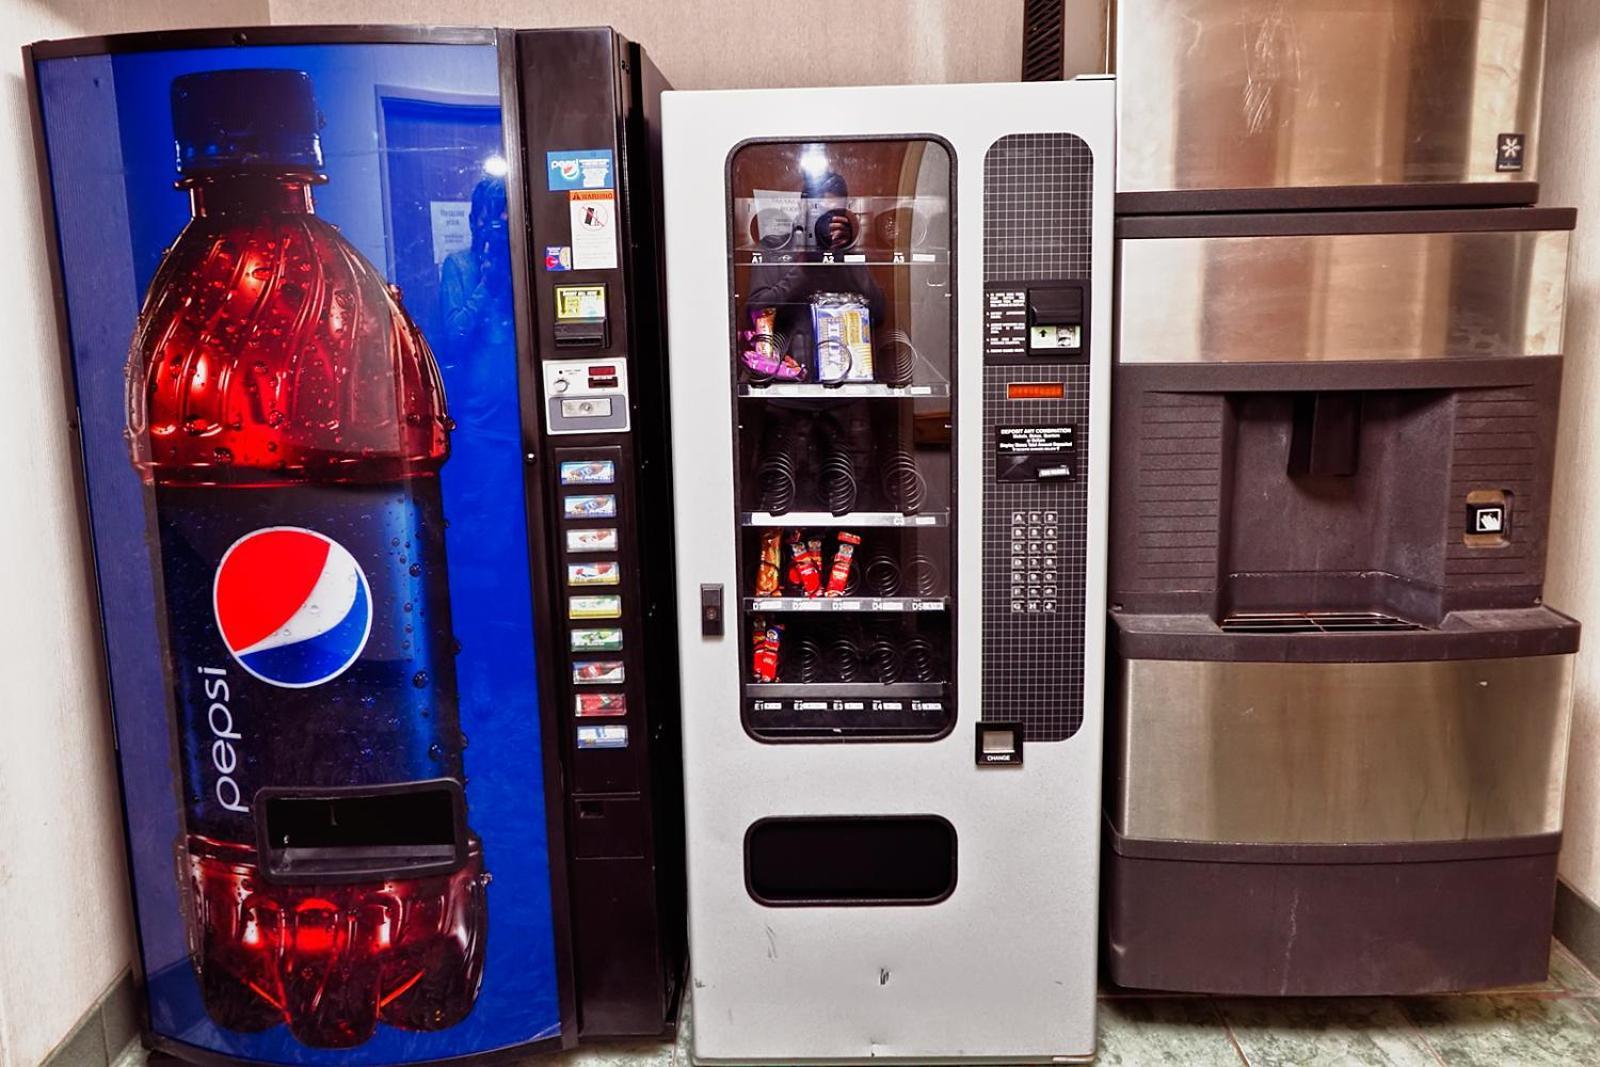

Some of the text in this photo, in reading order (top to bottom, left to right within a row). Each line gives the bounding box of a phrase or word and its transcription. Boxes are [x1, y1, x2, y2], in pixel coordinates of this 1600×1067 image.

[752, 255, 905, 265] A1 A2 A3
[197, 666, 250, 813] pepsi
[986, 754, 1011, 762] CHANGE
